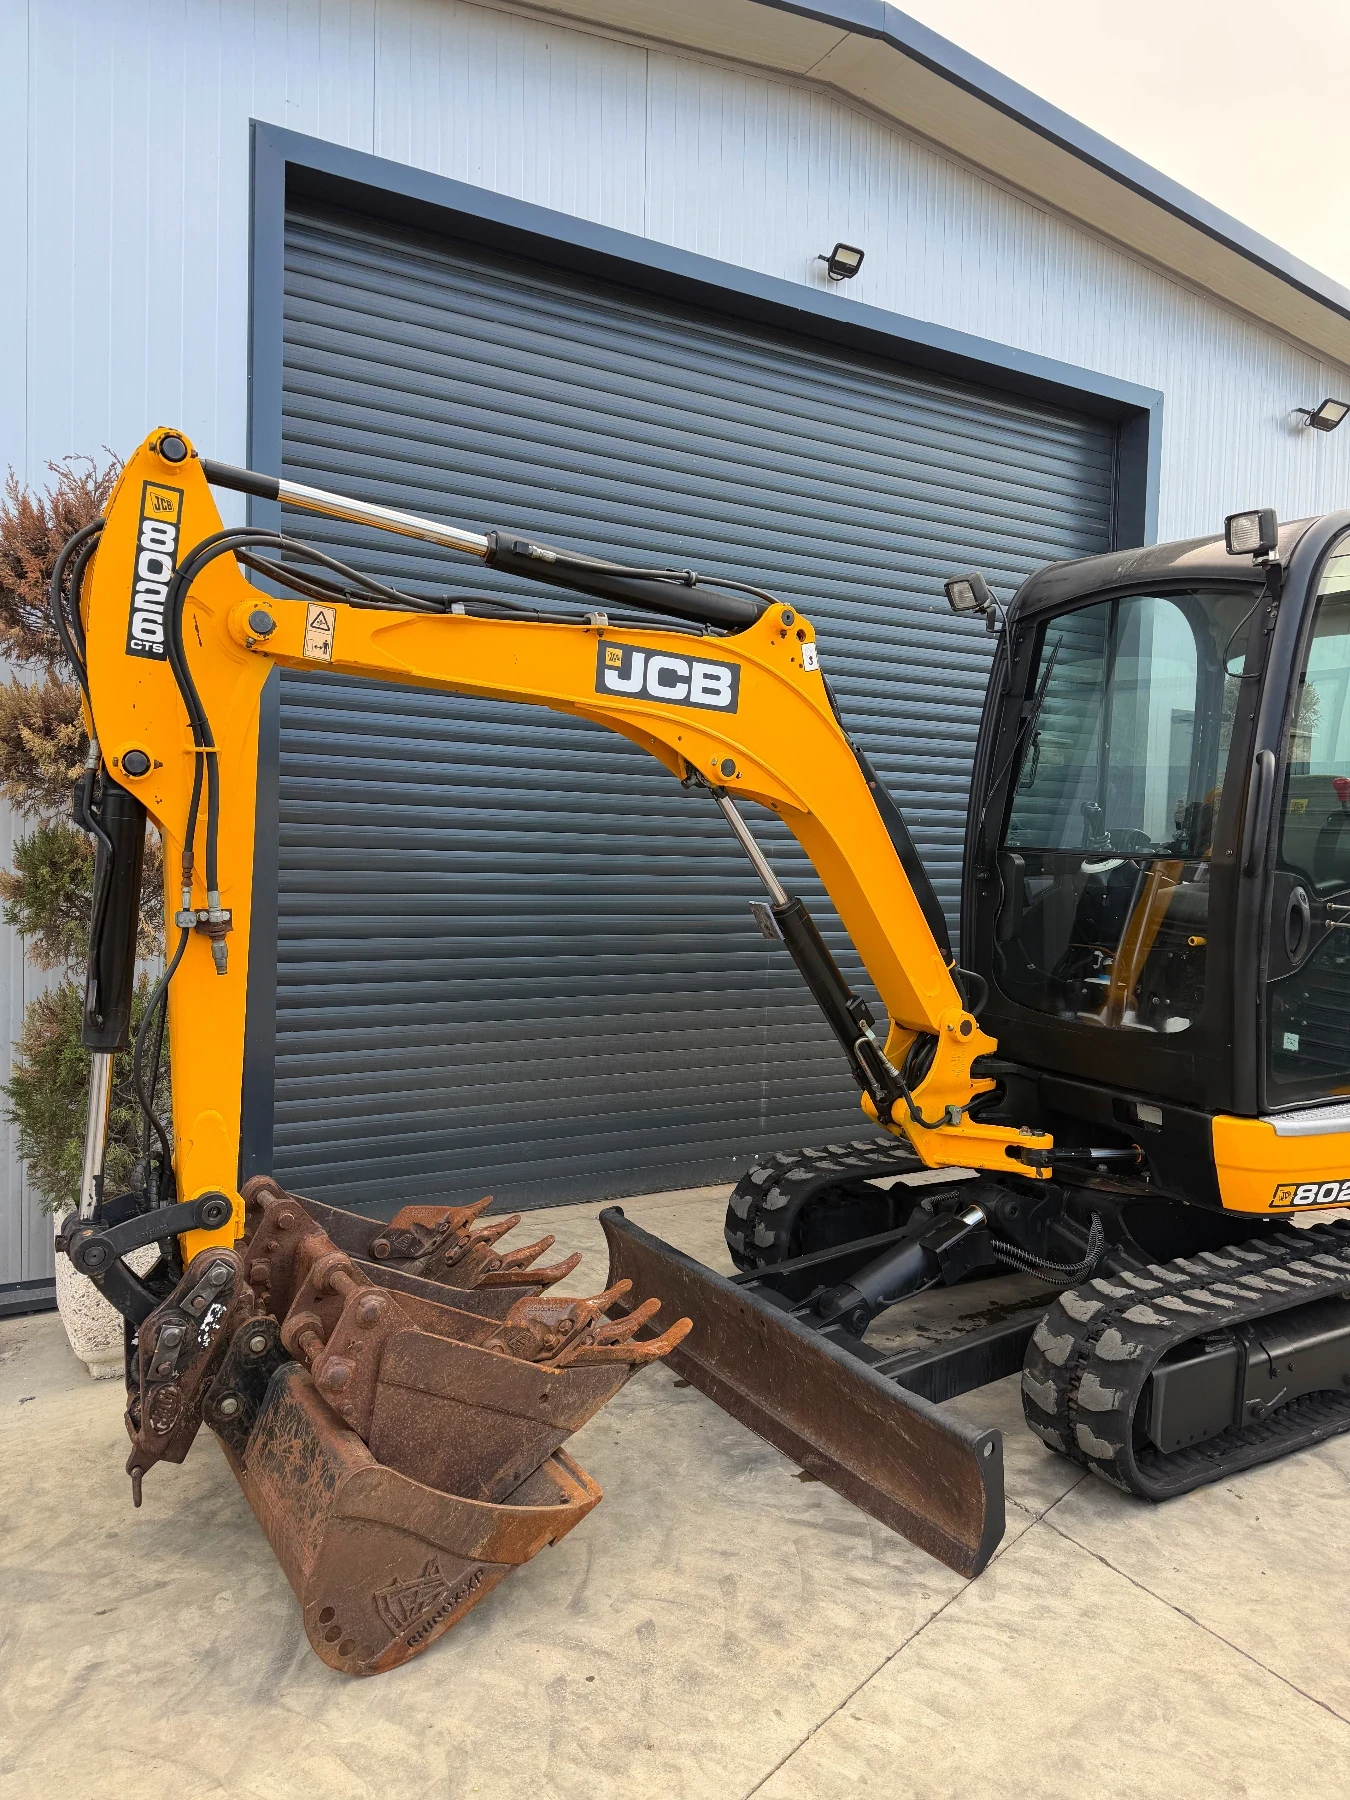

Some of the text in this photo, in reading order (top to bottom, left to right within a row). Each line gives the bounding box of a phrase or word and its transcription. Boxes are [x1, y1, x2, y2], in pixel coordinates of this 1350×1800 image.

[153, 495, 174, 512] JCB
[131, 519, 176, 643] 8026
[130, 639, 164, 654] CTS
[604, 651, 733, 707] JCB
